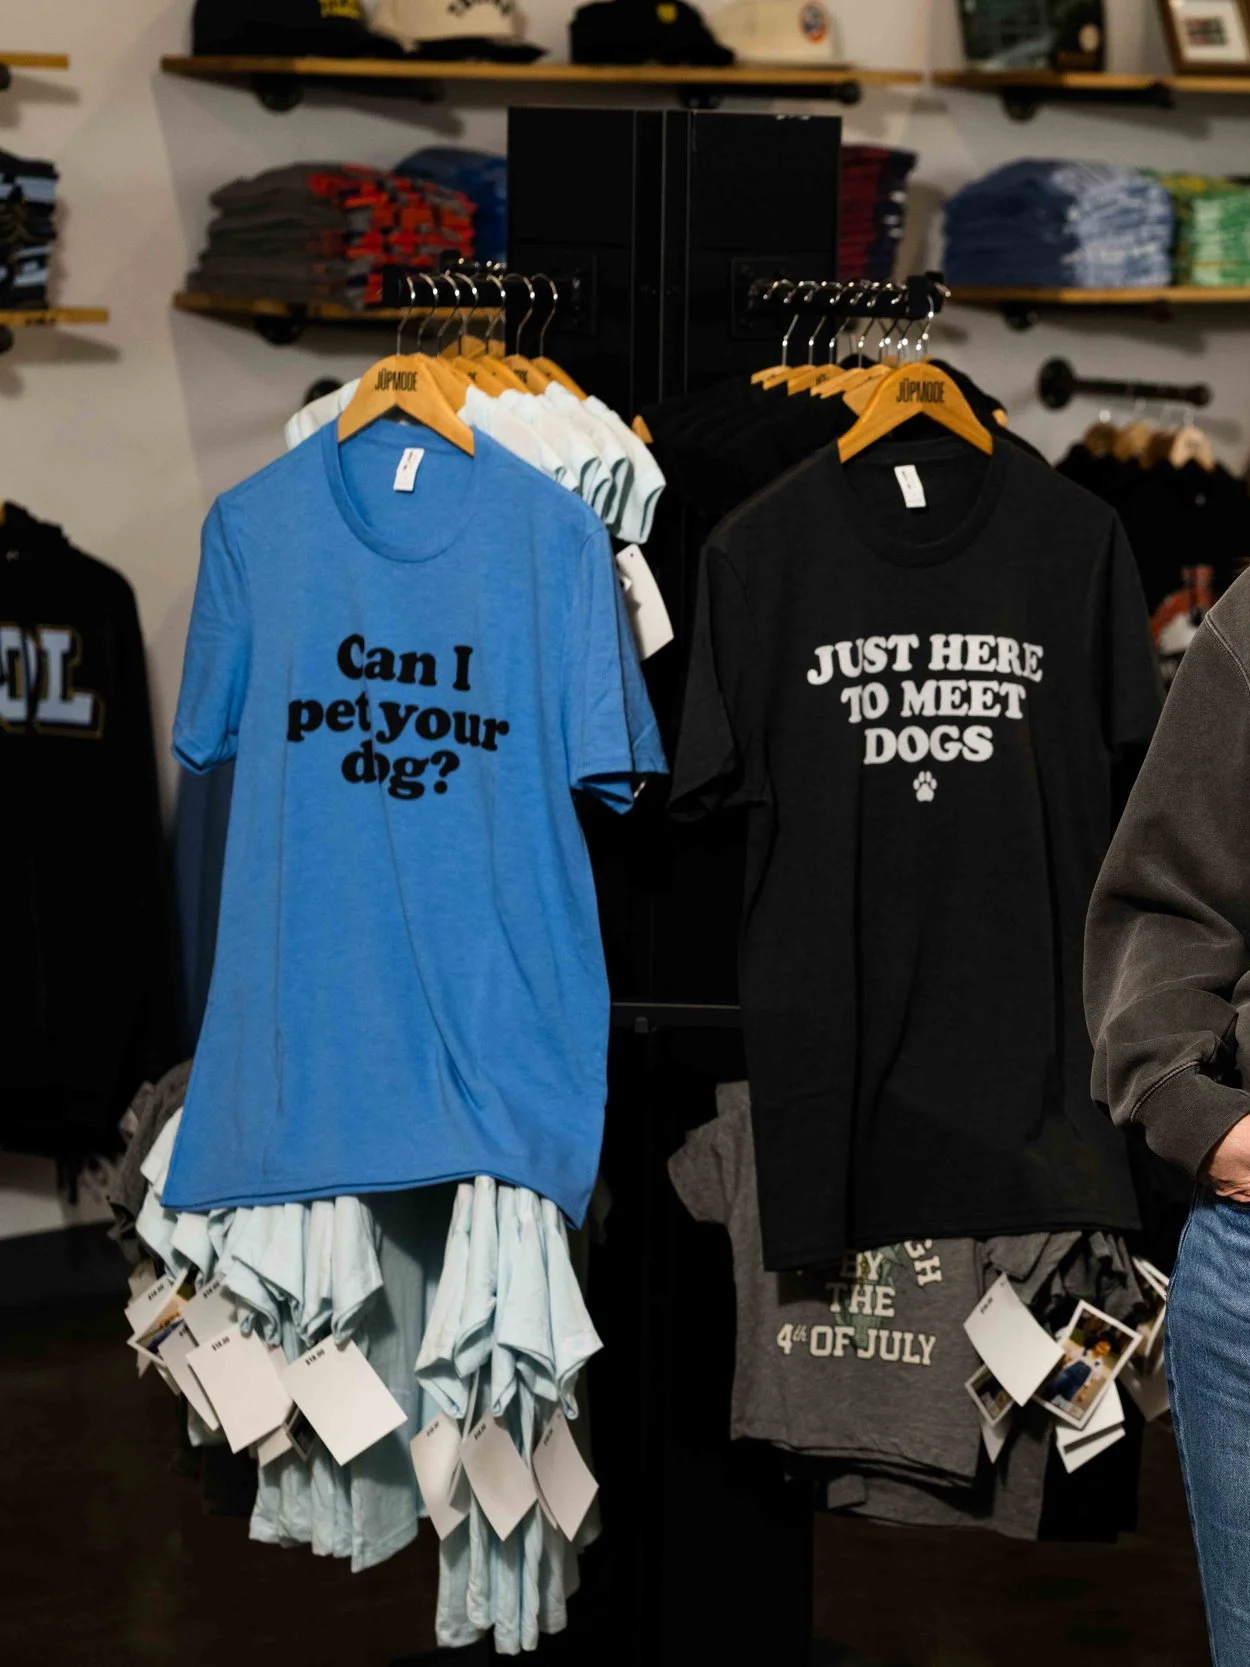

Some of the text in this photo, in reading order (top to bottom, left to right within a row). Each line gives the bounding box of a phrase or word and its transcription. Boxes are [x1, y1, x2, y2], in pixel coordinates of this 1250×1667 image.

[337, 634, 473, 691] Can I
[807, 633, 1044, 686] JUST HERE
[287, 691, 510, 751] pet your
[840, 679, 1026, 723] TO MEET
[863, 725, 994, 765] DOGS
[341, 739, 461, 800] dog?
[826, 1282, 896, 1318] THE
[777, 1323, 936, 1366] 4th OF JULY
